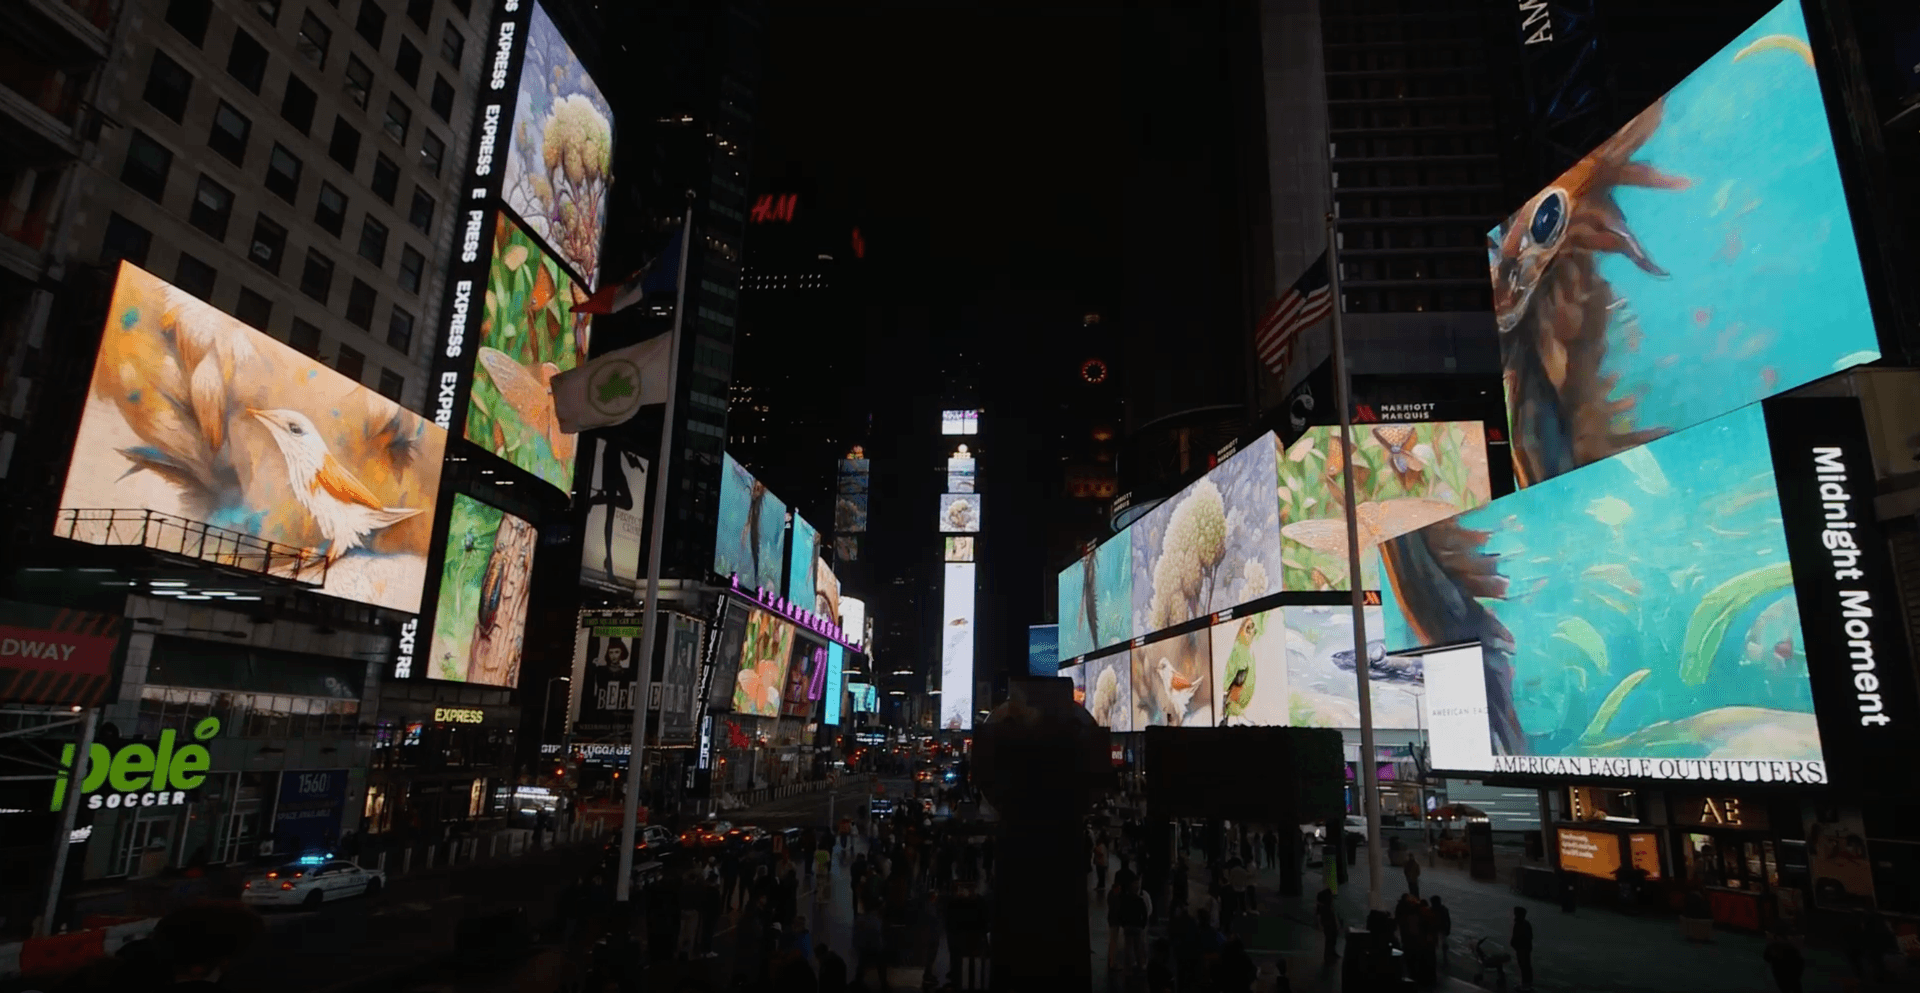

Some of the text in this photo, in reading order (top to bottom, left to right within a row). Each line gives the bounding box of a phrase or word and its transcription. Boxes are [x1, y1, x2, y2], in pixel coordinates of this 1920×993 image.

[490, 21, 515, 91] EXPRESS
[475, 104, 501, 177] EXPRESS
[446, 280, 472, 359] EXPRESS
[1381, 403, 1435, 412] MARRIOTT
[1381, 411, 1430, 420] MARQUIS
[1812, 447, 1890, 726] Midnight Moment
[1, 638, 76, 661] DWAY
[597, 681, 662, 710] BEETE
[434, 707, 484, 724] EXPRESS
[1432, 707, 1469, 717] AMERICAN
[50, 716, 221, 812] pelé
[1493, 756, 1825, 784] AMERICAN EAGLE OUTFITTERS
[299, 773, 328, 793] 1560
[87, 791, 186, 810] SOCCER
[1701, 797, 1742, 825] AE
